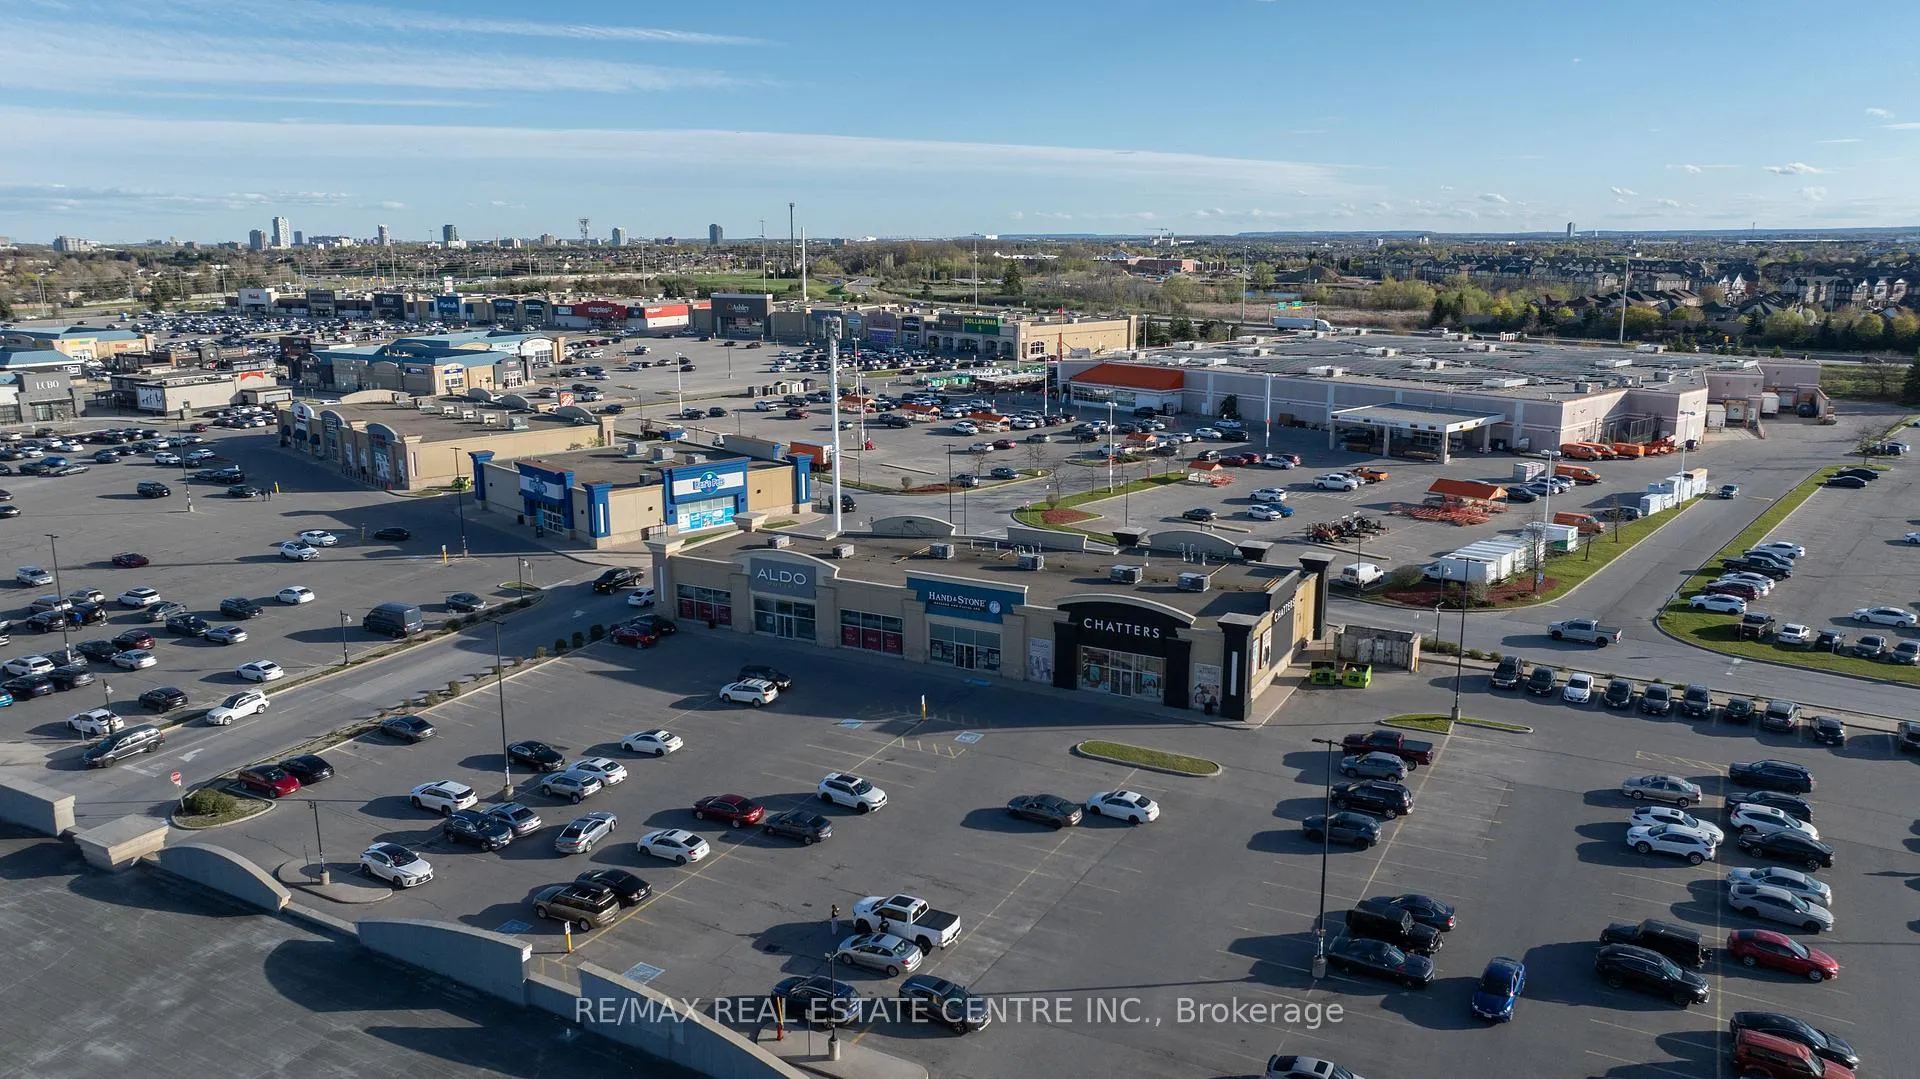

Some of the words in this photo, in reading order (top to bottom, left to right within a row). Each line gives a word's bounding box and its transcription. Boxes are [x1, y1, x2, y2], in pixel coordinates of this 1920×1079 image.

[588, 306, 609, 314] staples
[732, 303, 749, 311] Ashley
[964, 318, 997, 326] DOLLARAMA
[36, 380, 59, 390] LCBO
[757, 568, 807, 585] ALDO
[1274, 599, 1296, 622] CHATTERS
[1083, 617, 1160, 639] CHATTERS
